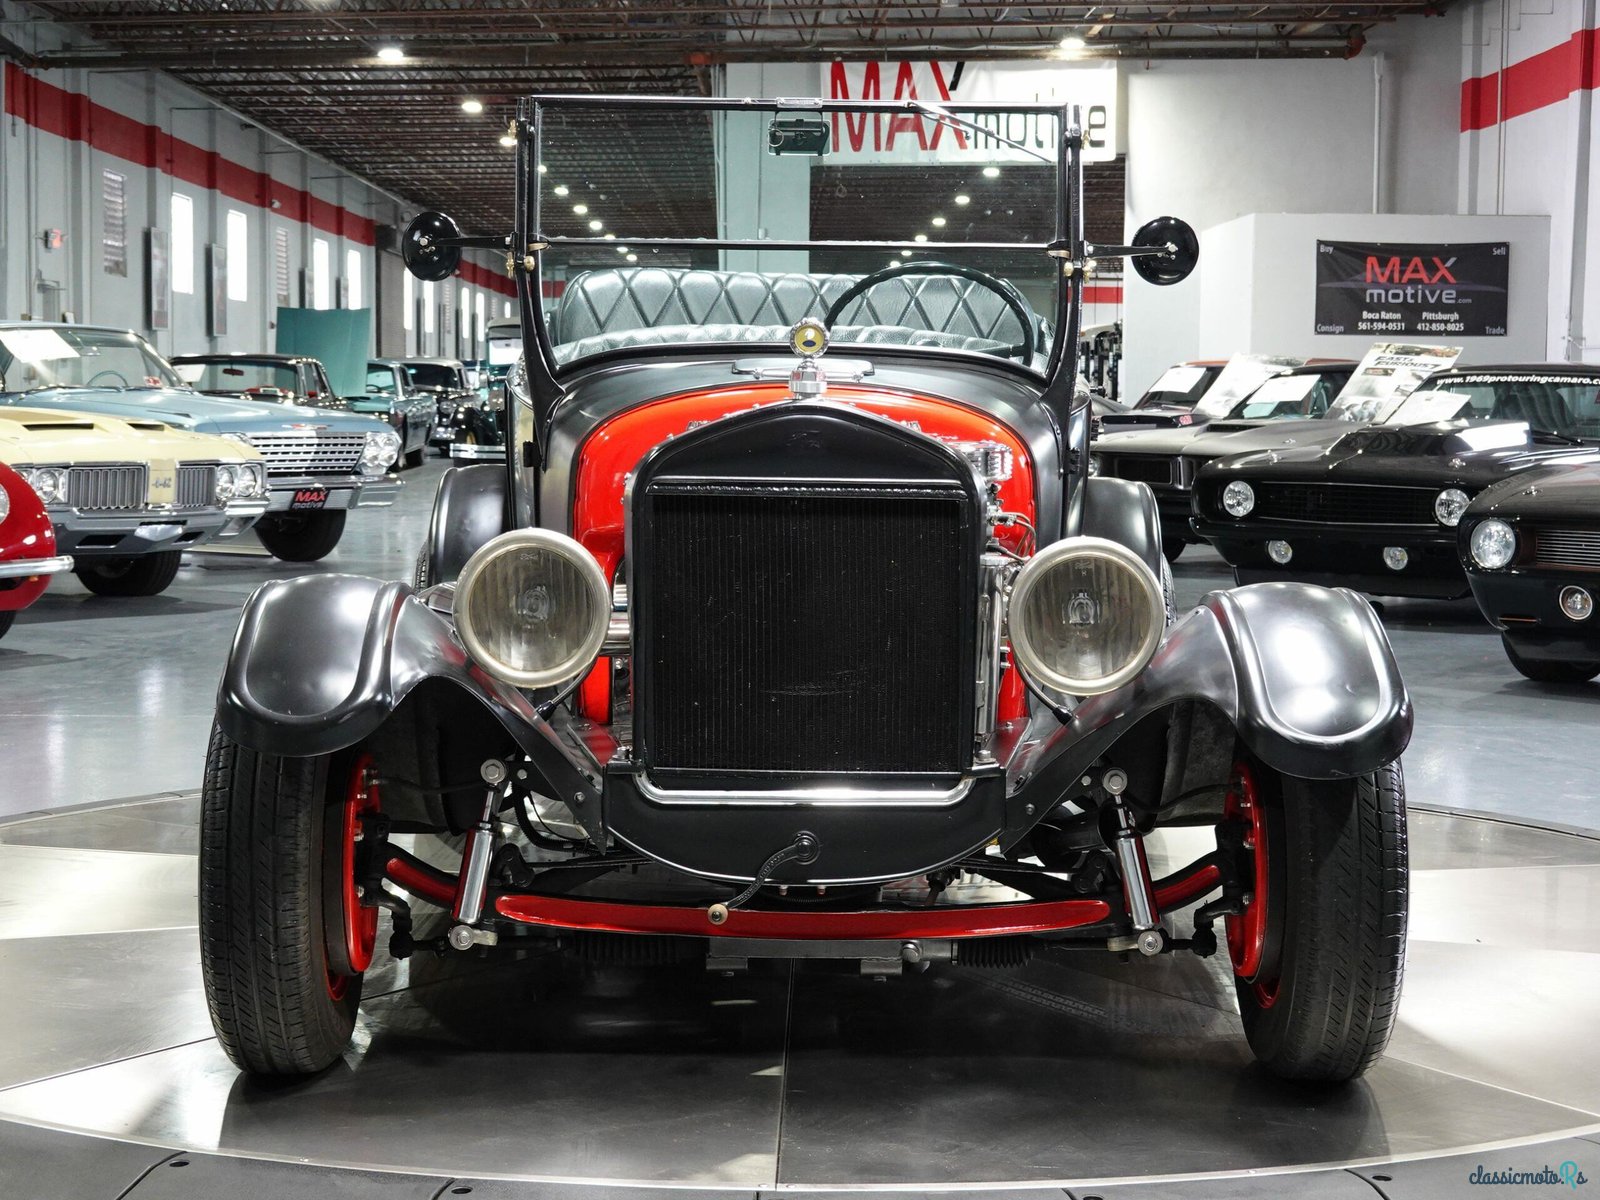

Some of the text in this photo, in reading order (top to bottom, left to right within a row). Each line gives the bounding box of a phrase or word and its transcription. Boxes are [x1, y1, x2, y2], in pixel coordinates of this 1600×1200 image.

[831, 59, 968, 153] MAX
[973, 87, 1107, 150] motie
[1319, 245, 1334, 254] Buy
[1492, 247, 1506, 256] Sell
[1366, 256, 1458, 284] MAX
[1366, 285, 1457, 304] motive
[1362, 311, 1402, 320] Boca Raton
[1422, 311, 1460, 322] Pittsburgh
[1316, 323, 1344, 334] Consign
[1358, 321, 1405, 331] 561-594-0531
[1417, 322, 1464, 332] 412-850-8025
[1485, 326, 1506, 335] Trade
[295, 490, 327, 501] MAX
